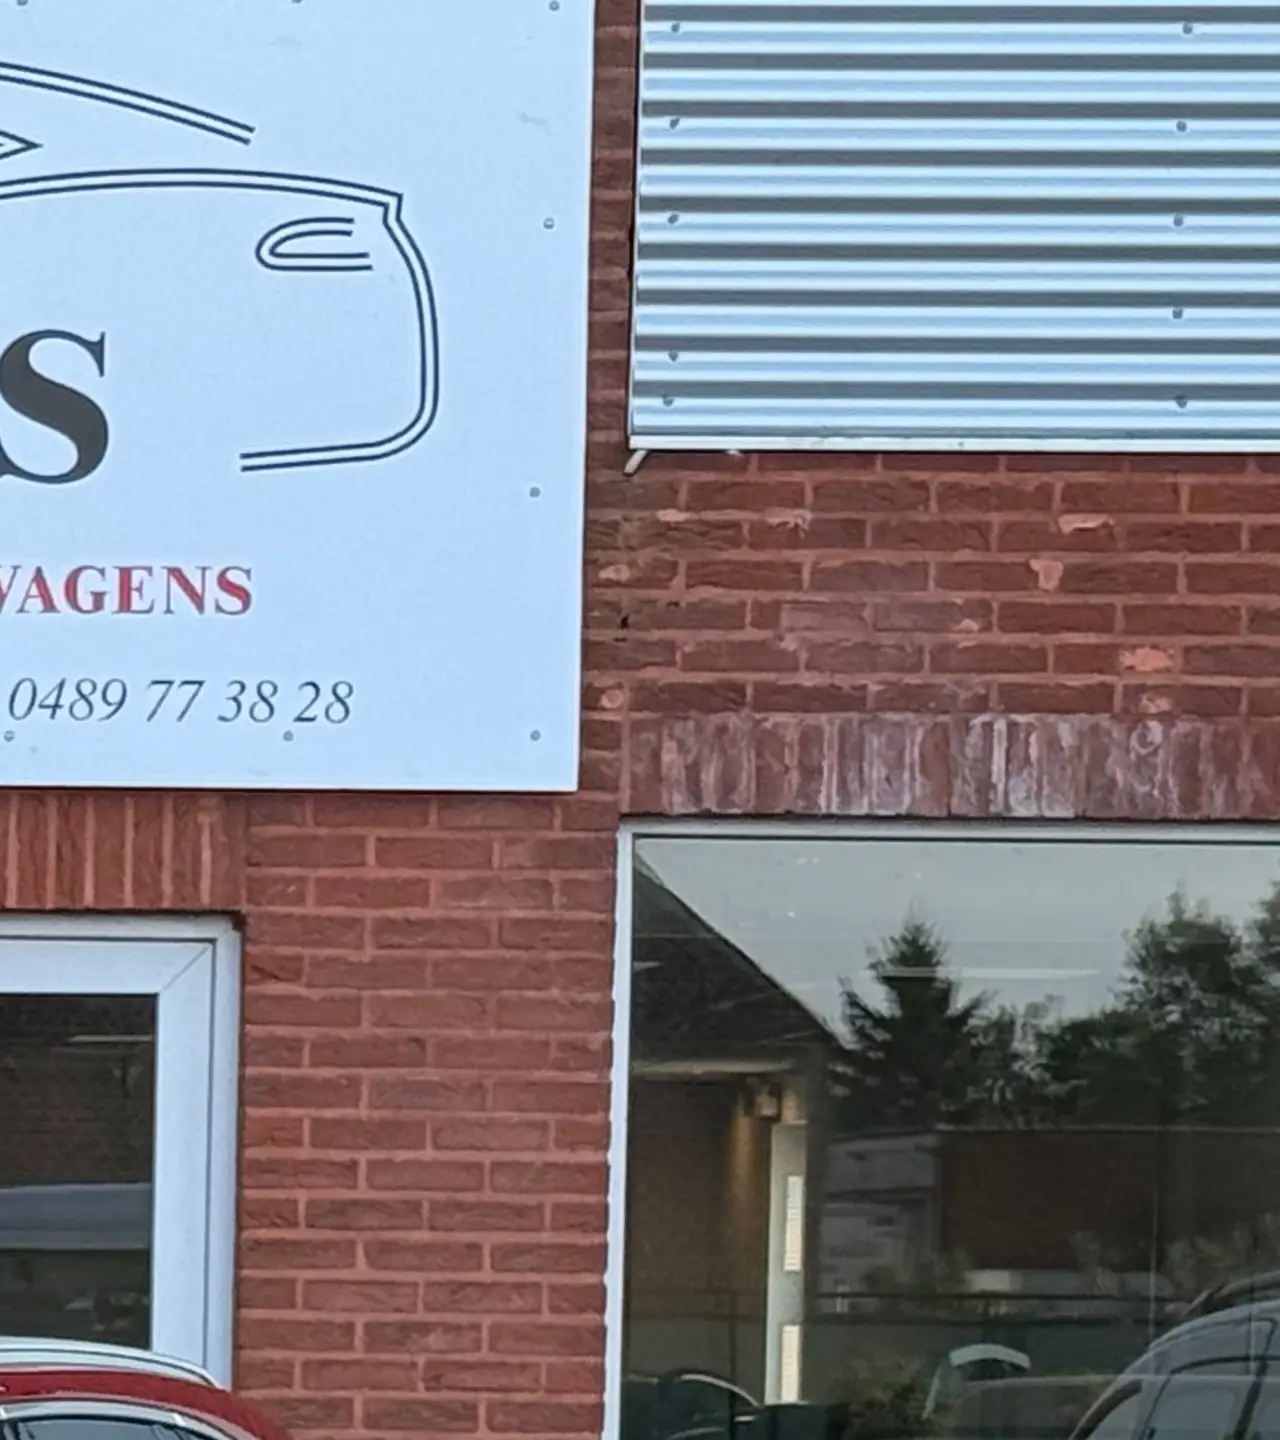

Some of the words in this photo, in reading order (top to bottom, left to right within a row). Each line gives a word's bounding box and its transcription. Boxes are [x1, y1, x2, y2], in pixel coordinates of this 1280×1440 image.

[6, 677, 128, 722] 0489
[146, 679, 206, 724] 77
[218, 680, 280, 725] 38
[292, 681, 354, 726] 28
